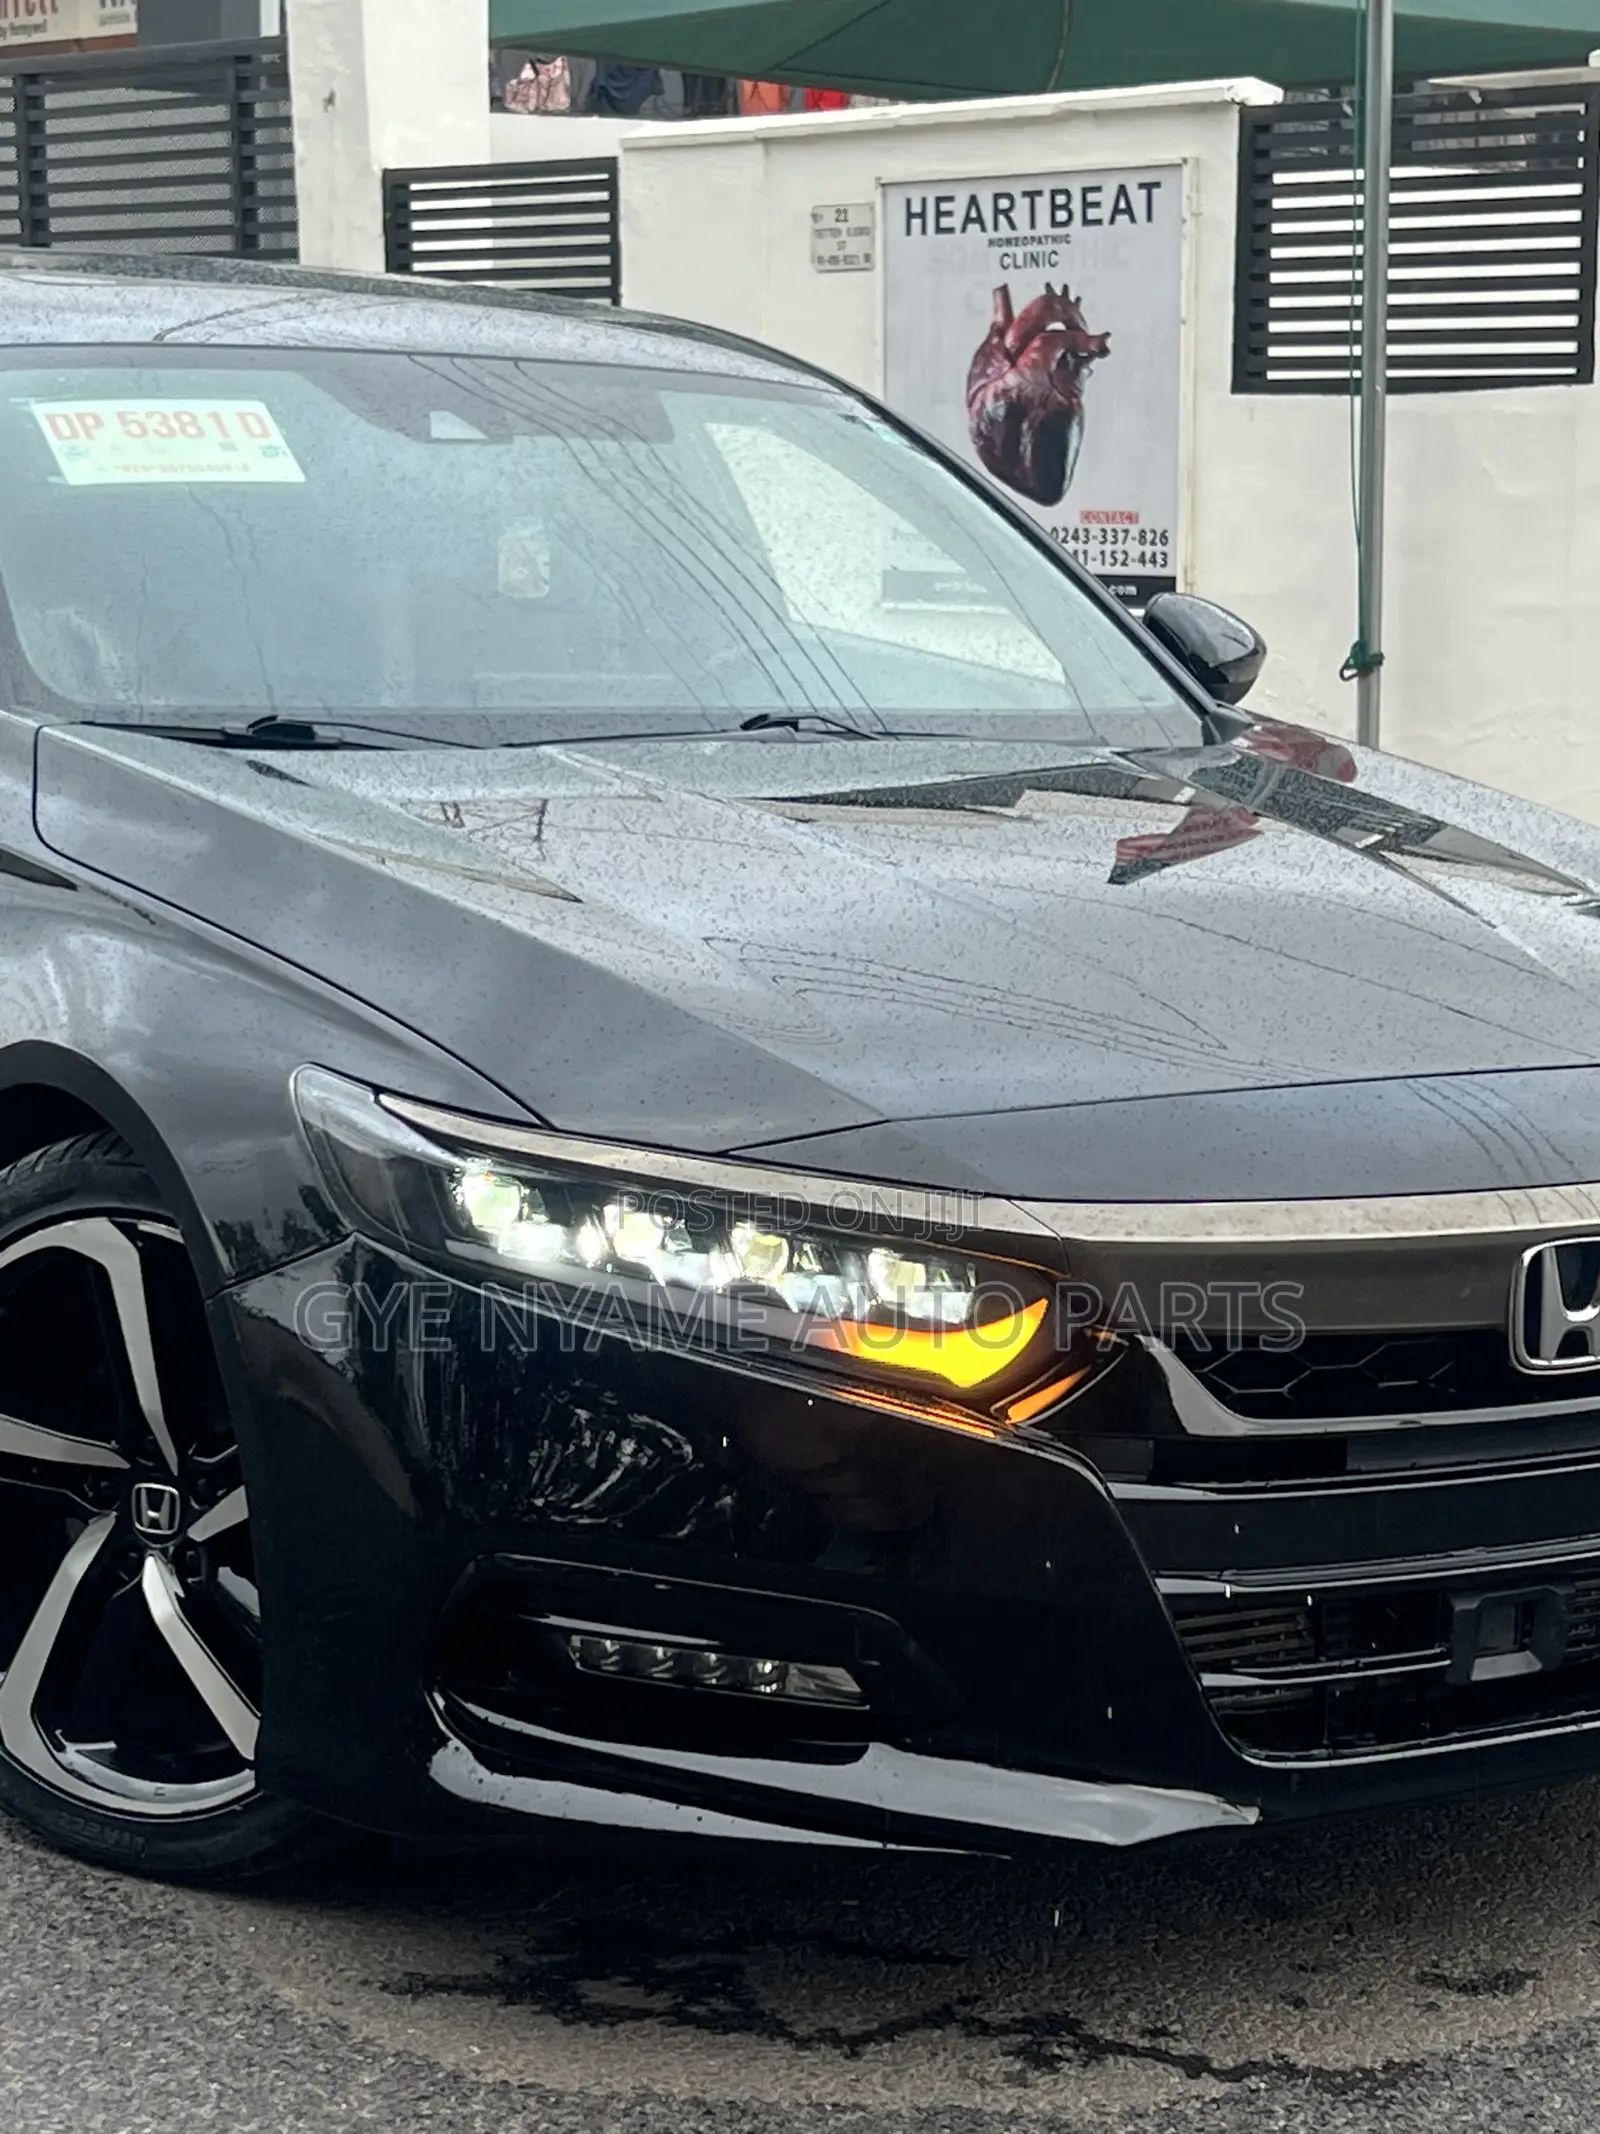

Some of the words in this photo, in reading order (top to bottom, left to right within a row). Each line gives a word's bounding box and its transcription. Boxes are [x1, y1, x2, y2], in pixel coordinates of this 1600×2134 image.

[905, 181, 1162, 237] HEARTBEAT
[987, 232, 1072, 248] HOMEOPATHIC
[999, 250, 1060, 271] CLINIC
[44, 412, 105, 441] DP
[115, 410, 231, 440] 5381
[235, 411, 272, 439] D
[1050, 526, 1169, 546] 0243-337-826
